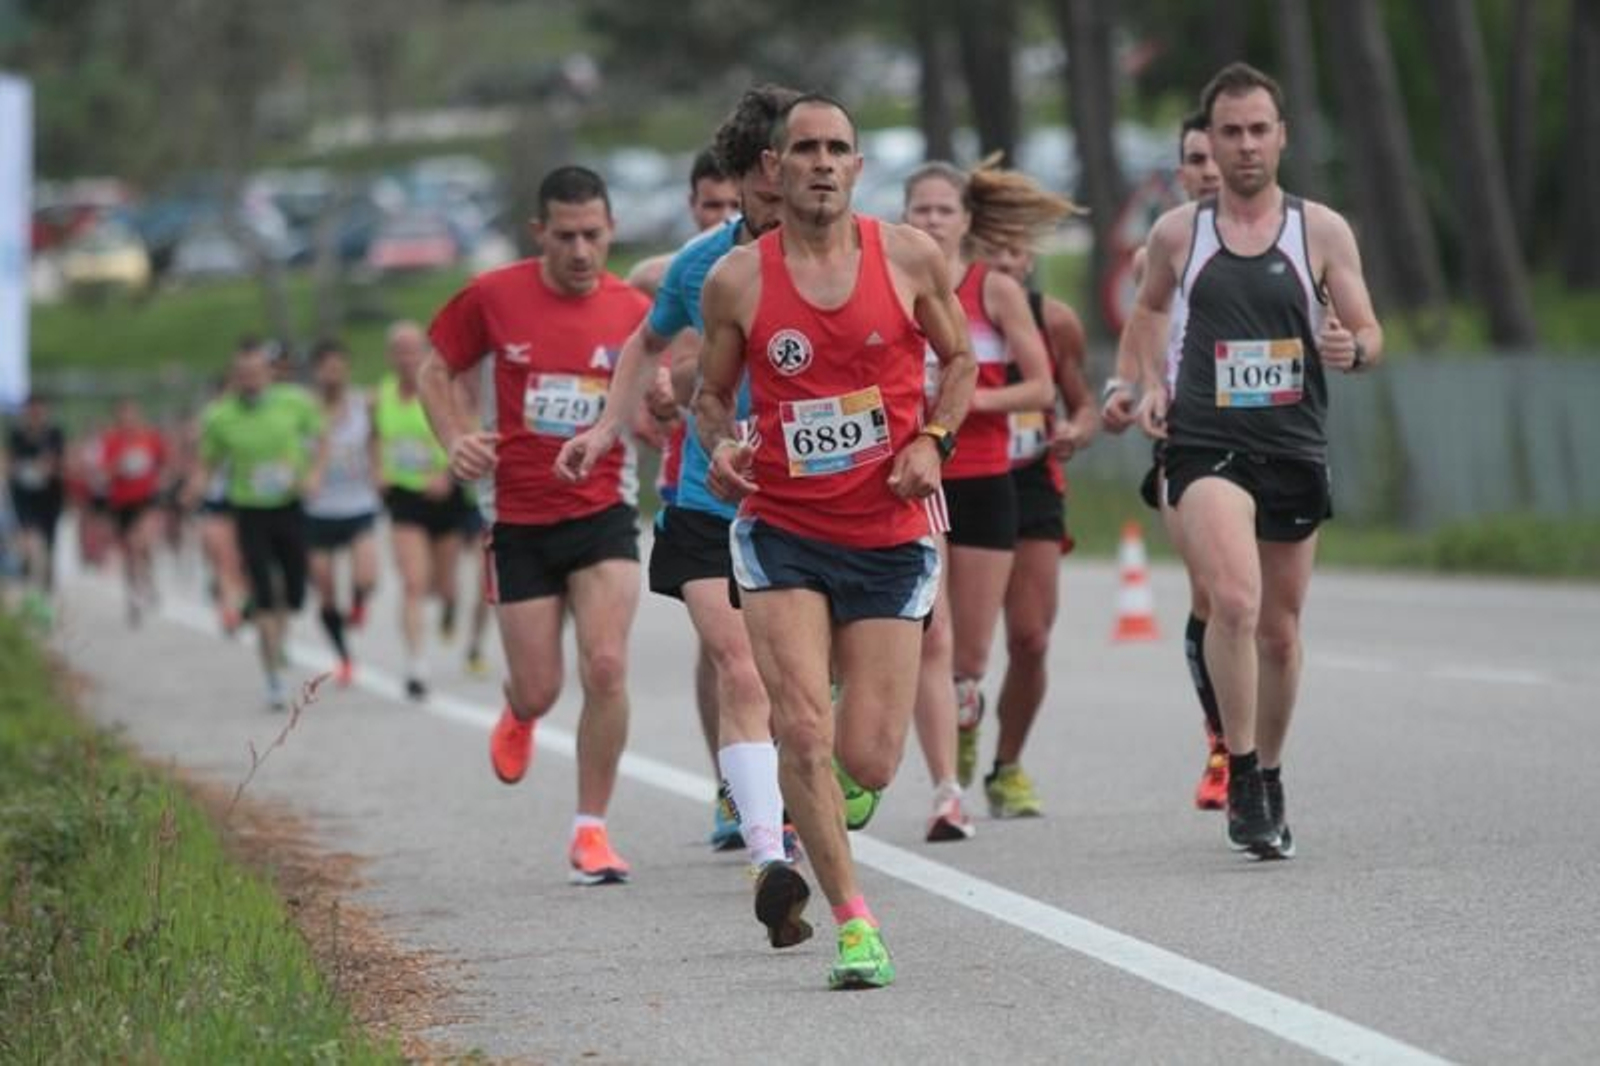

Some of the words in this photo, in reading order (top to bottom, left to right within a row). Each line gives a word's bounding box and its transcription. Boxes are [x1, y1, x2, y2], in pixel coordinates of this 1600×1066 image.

[1227, 365, 1282, 388] 106
[534, 396, 590, 420] 779
[793, 420, 862, 456] 689
